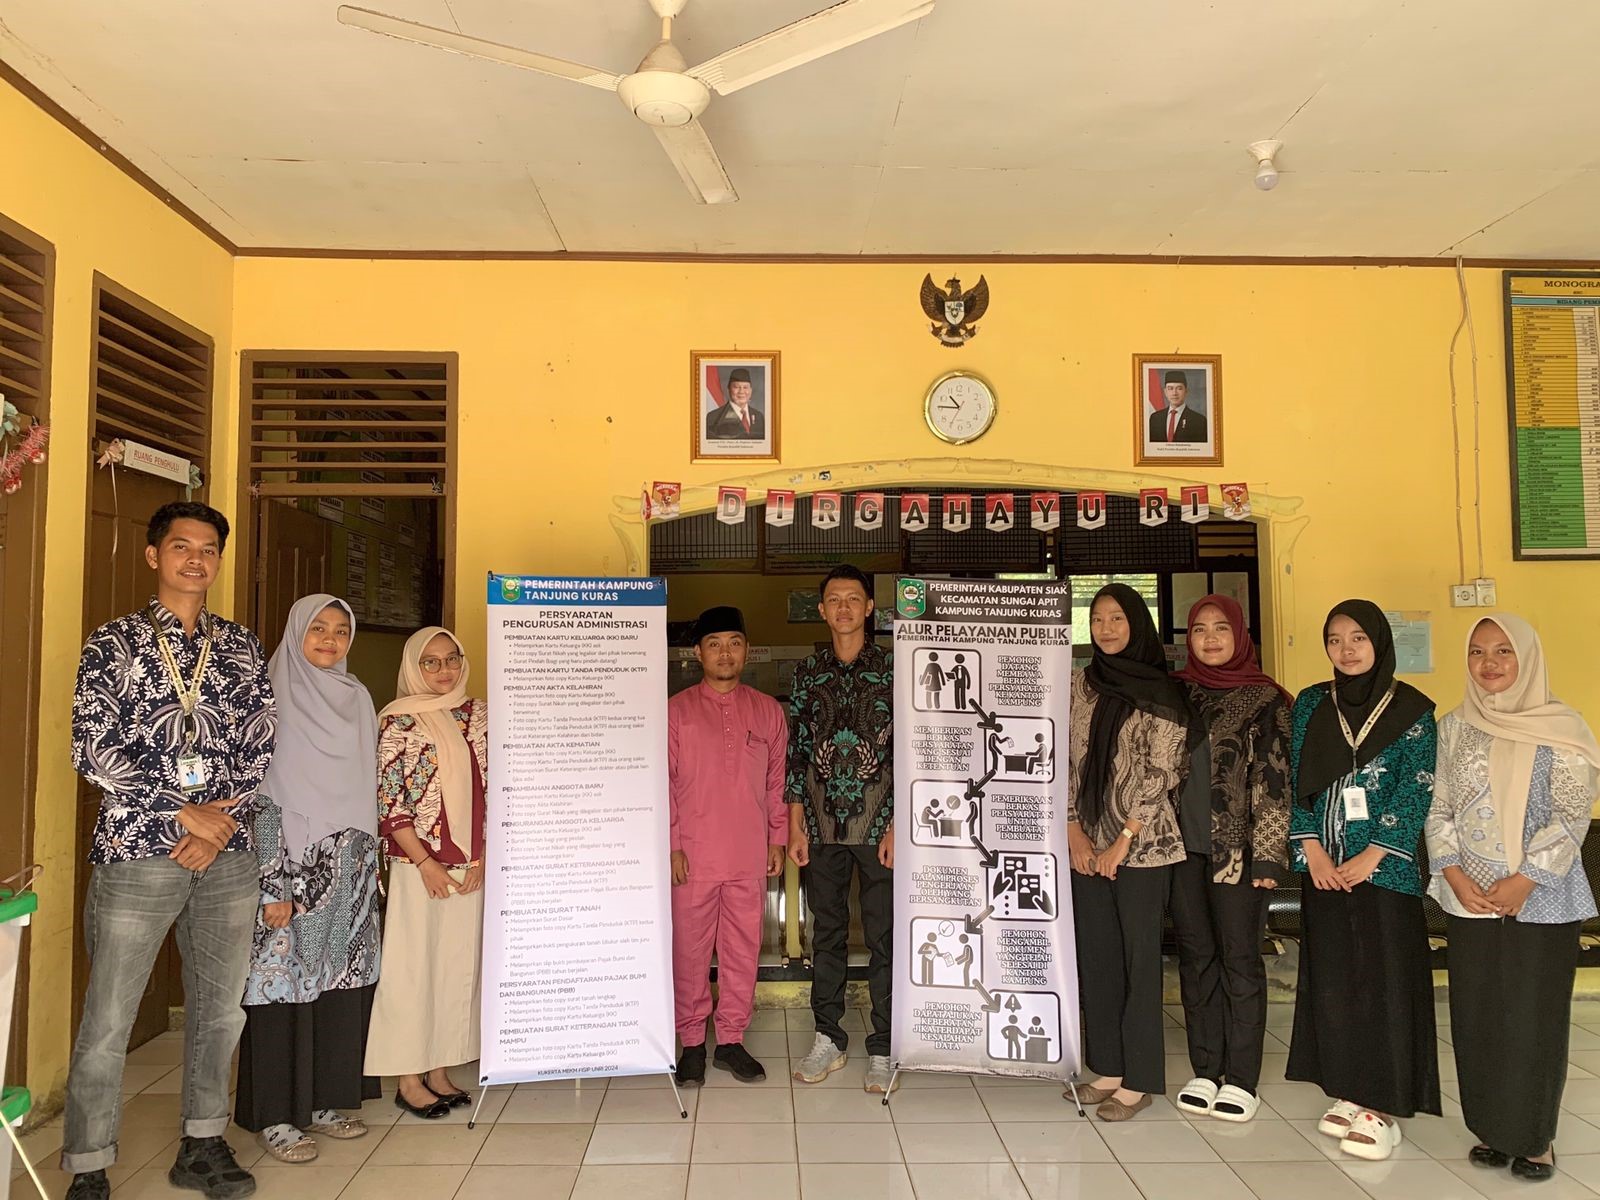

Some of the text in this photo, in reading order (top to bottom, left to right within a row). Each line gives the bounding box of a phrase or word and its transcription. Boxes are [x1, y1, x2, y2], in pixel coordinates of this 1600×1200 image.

[134, 450, 180, 472] RUANG PENGHULU
[525, 580, 653, 590] PEMERINTAH KAMPUNG
[930, 584, 1067, 595] PEMERINTAH KABUPATEN SIAK
[526, 591, 618, 600] TANJUNG KURAS
[941, 596, 999, 604] KECAMATAN
[1001, 597, 1036, 605] SUNGAI
[936, 607, 1061, 618] KAMPUNG TANJUNG KURAS
[898, 623, 1067, 639] ALUR PELAYANAN PUBLIK
[989, 683, 1051, 692] PERSYARATAN
[914, 726, 972, 735] MEMBERIKAN
[912, 740, 974, 750] PERSYARATAN
[924, 755, 962, 763] DENGAN
[917, 762, 969, 771] KETENTUAN
[992, 794, 1052, 804] PEMERIKSAAN
[991, 809, 1053, 819] PERSYARATAN
[996, 824, 1049, 833] PEMBUATAN
[1001, 832, 1044, 841] DOKUMEN
[923, 866, 968, 875] DOKUMEN
[912, 872, 979, 883] DALAM PROSES
[916, 880, 975, 891] PENGERJAAN
[944, 890, 970, 898] YANG
[910, 895, 981, 906] BERSANGKUTAN
[500, 908, 547, 916] PEMBUATAN
[1002, 929, 1046, 938] PEMOHON
[997, 938, 1051, 946] MENGAMBIL
[997, 952, 1021, 961] YANG
[500, 980, 551, 988] PERSYARATAN
[1002, 976, 1047, 985] KAMPUNG
[925, 1002, 970, 1012] PEMOHON
[913, 1009, 943, 1018] DAPAT
[921, 1018, 974, 1028] KEBERATAN
[921, 1033, 974, 1043] KESALAHAN
[935, 1041, 960, 1050] DATA
